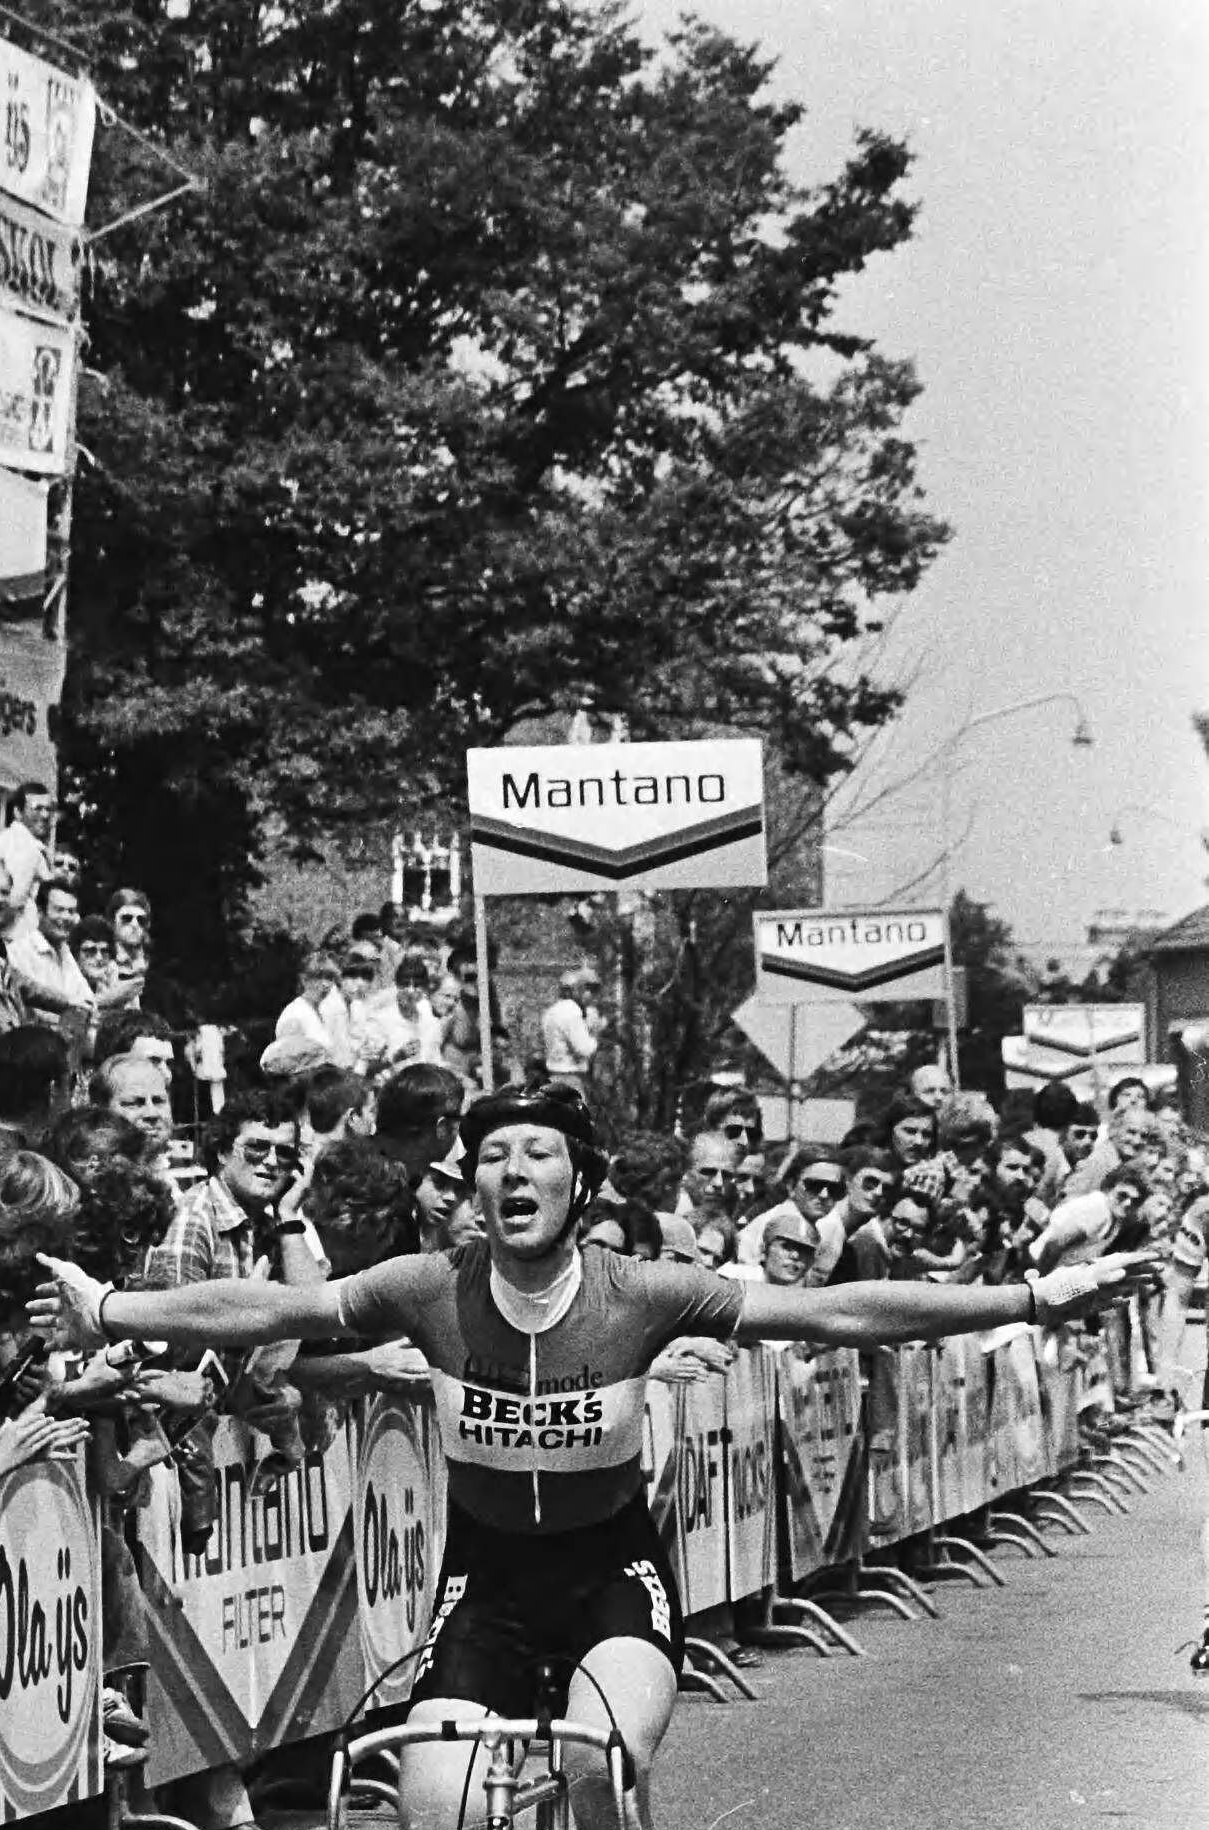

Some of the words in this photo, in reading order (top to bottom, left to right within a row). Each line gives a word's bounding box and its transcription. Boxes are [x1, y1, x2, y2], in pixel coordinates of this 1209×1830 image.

[502, 769, 726, 809] Mantano
[776, 918, 927, 947] Mantano
[459, 1420, 603, 1450] HITACHI
[362, 1480, 403, 1608] Ola
[55, 1545, 88, 1724] ijs
[222, 1584, 287, 1655] FILTER
